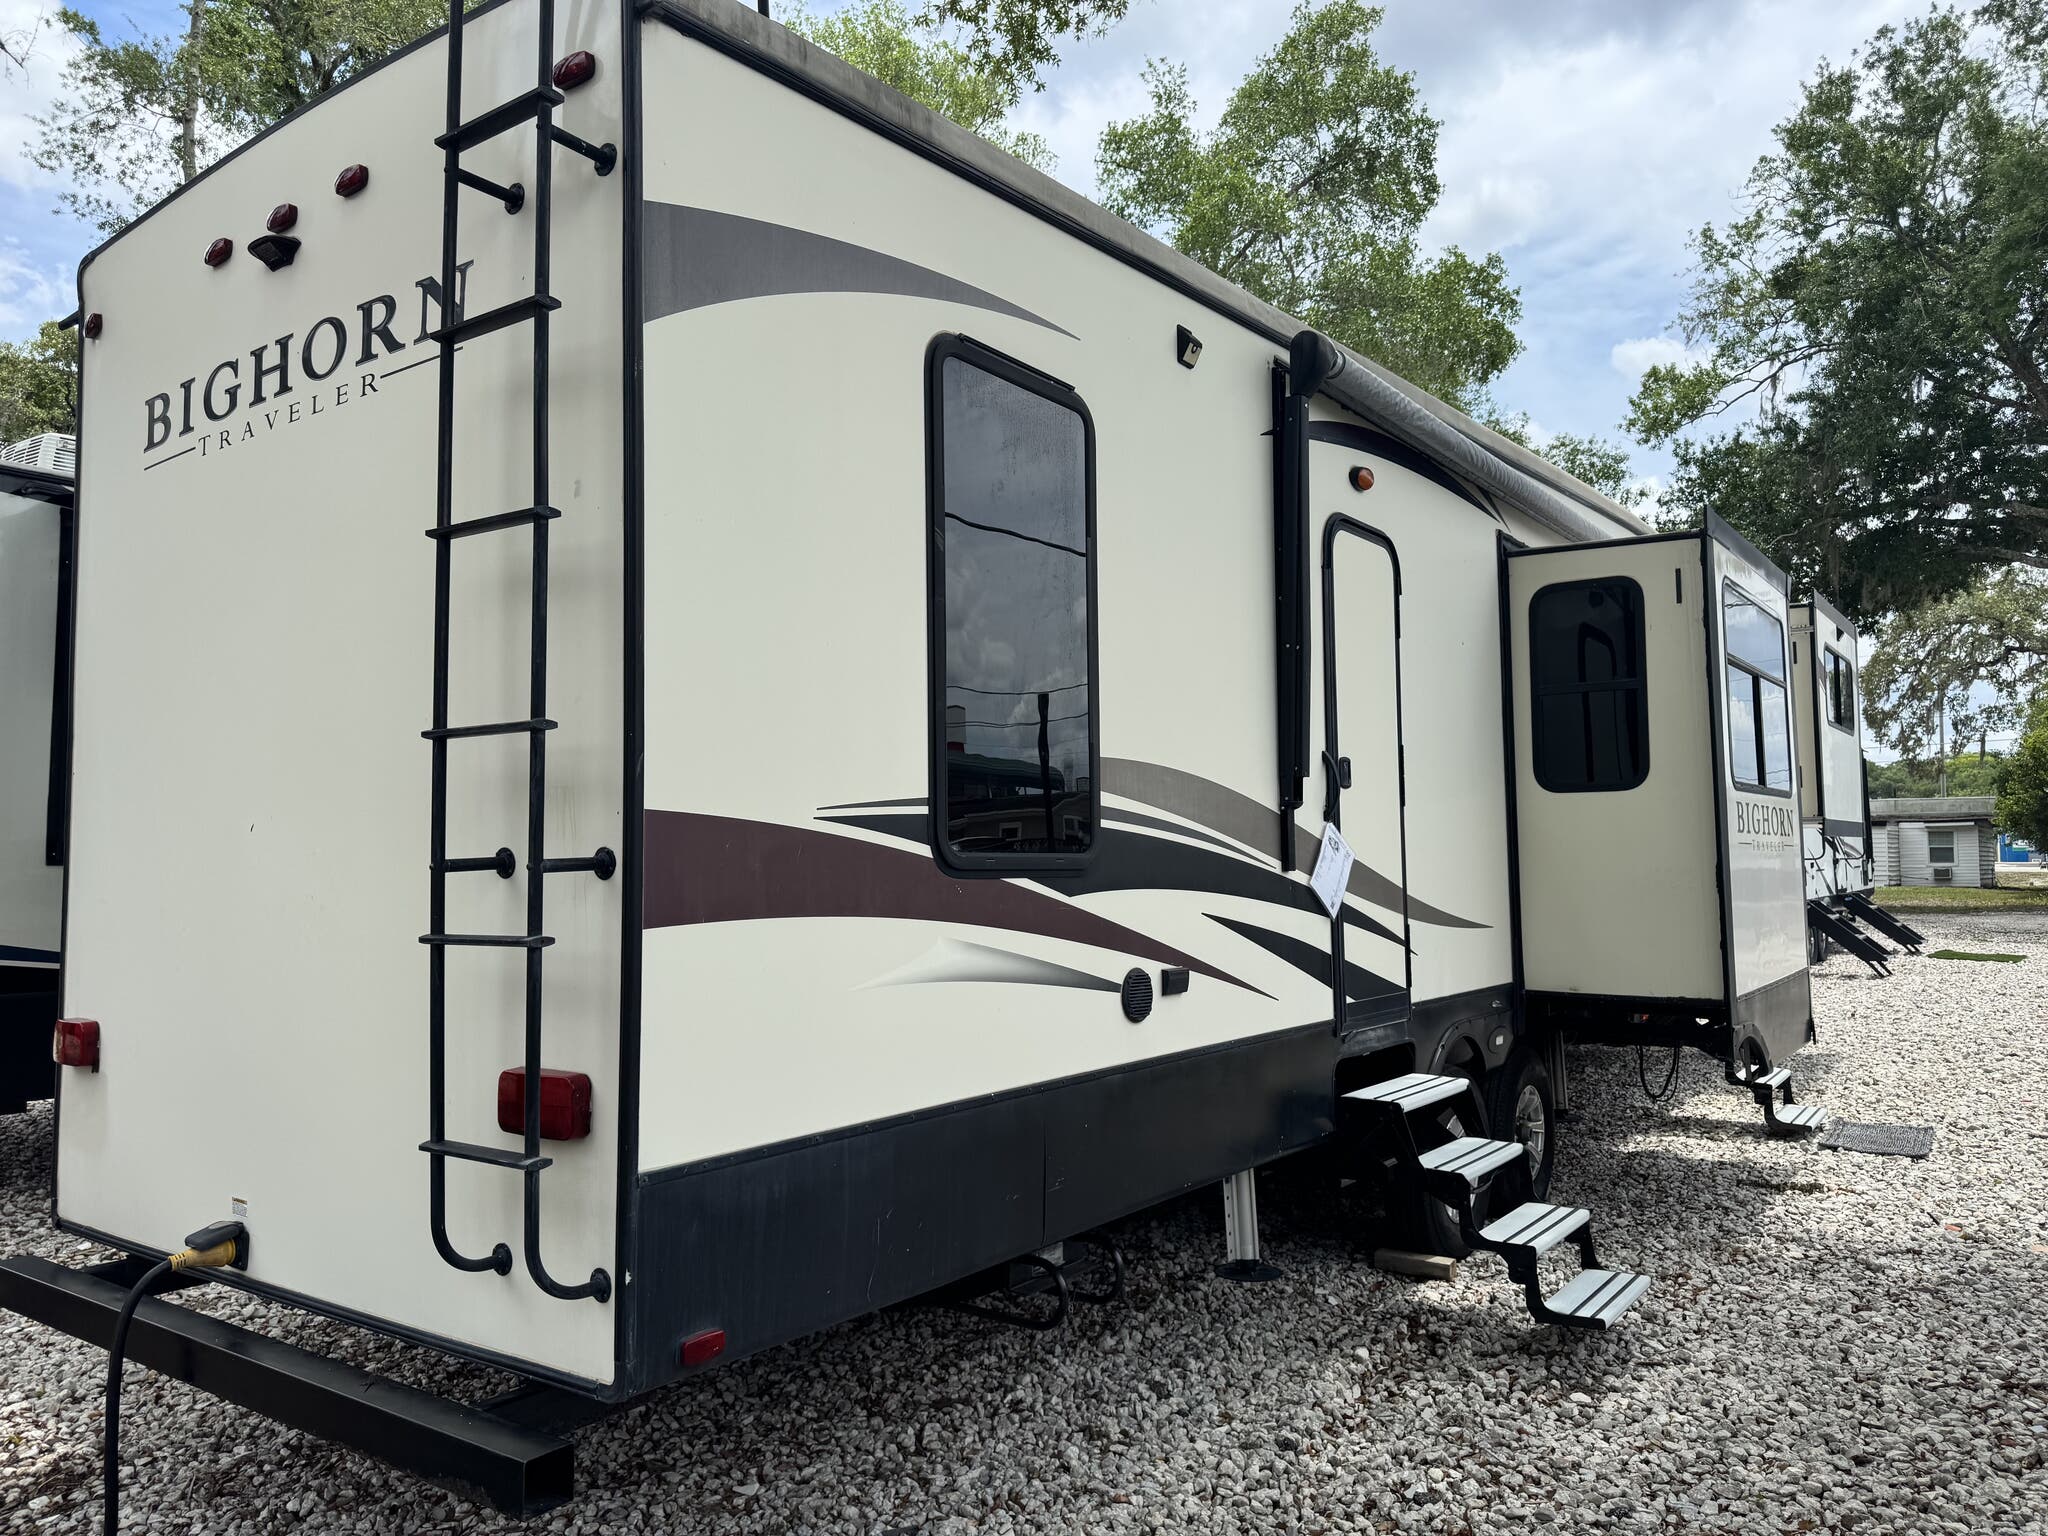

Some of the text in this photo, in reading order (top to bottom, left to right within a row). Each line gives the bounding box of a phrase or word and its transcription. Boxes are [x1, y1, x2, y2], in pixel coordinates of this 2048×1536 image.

[144, 259, 474, 453] BIGHORN
[198, 373, 379, 456] TRAVELER
[1736, 801, 1794, 837] BIGHORN
